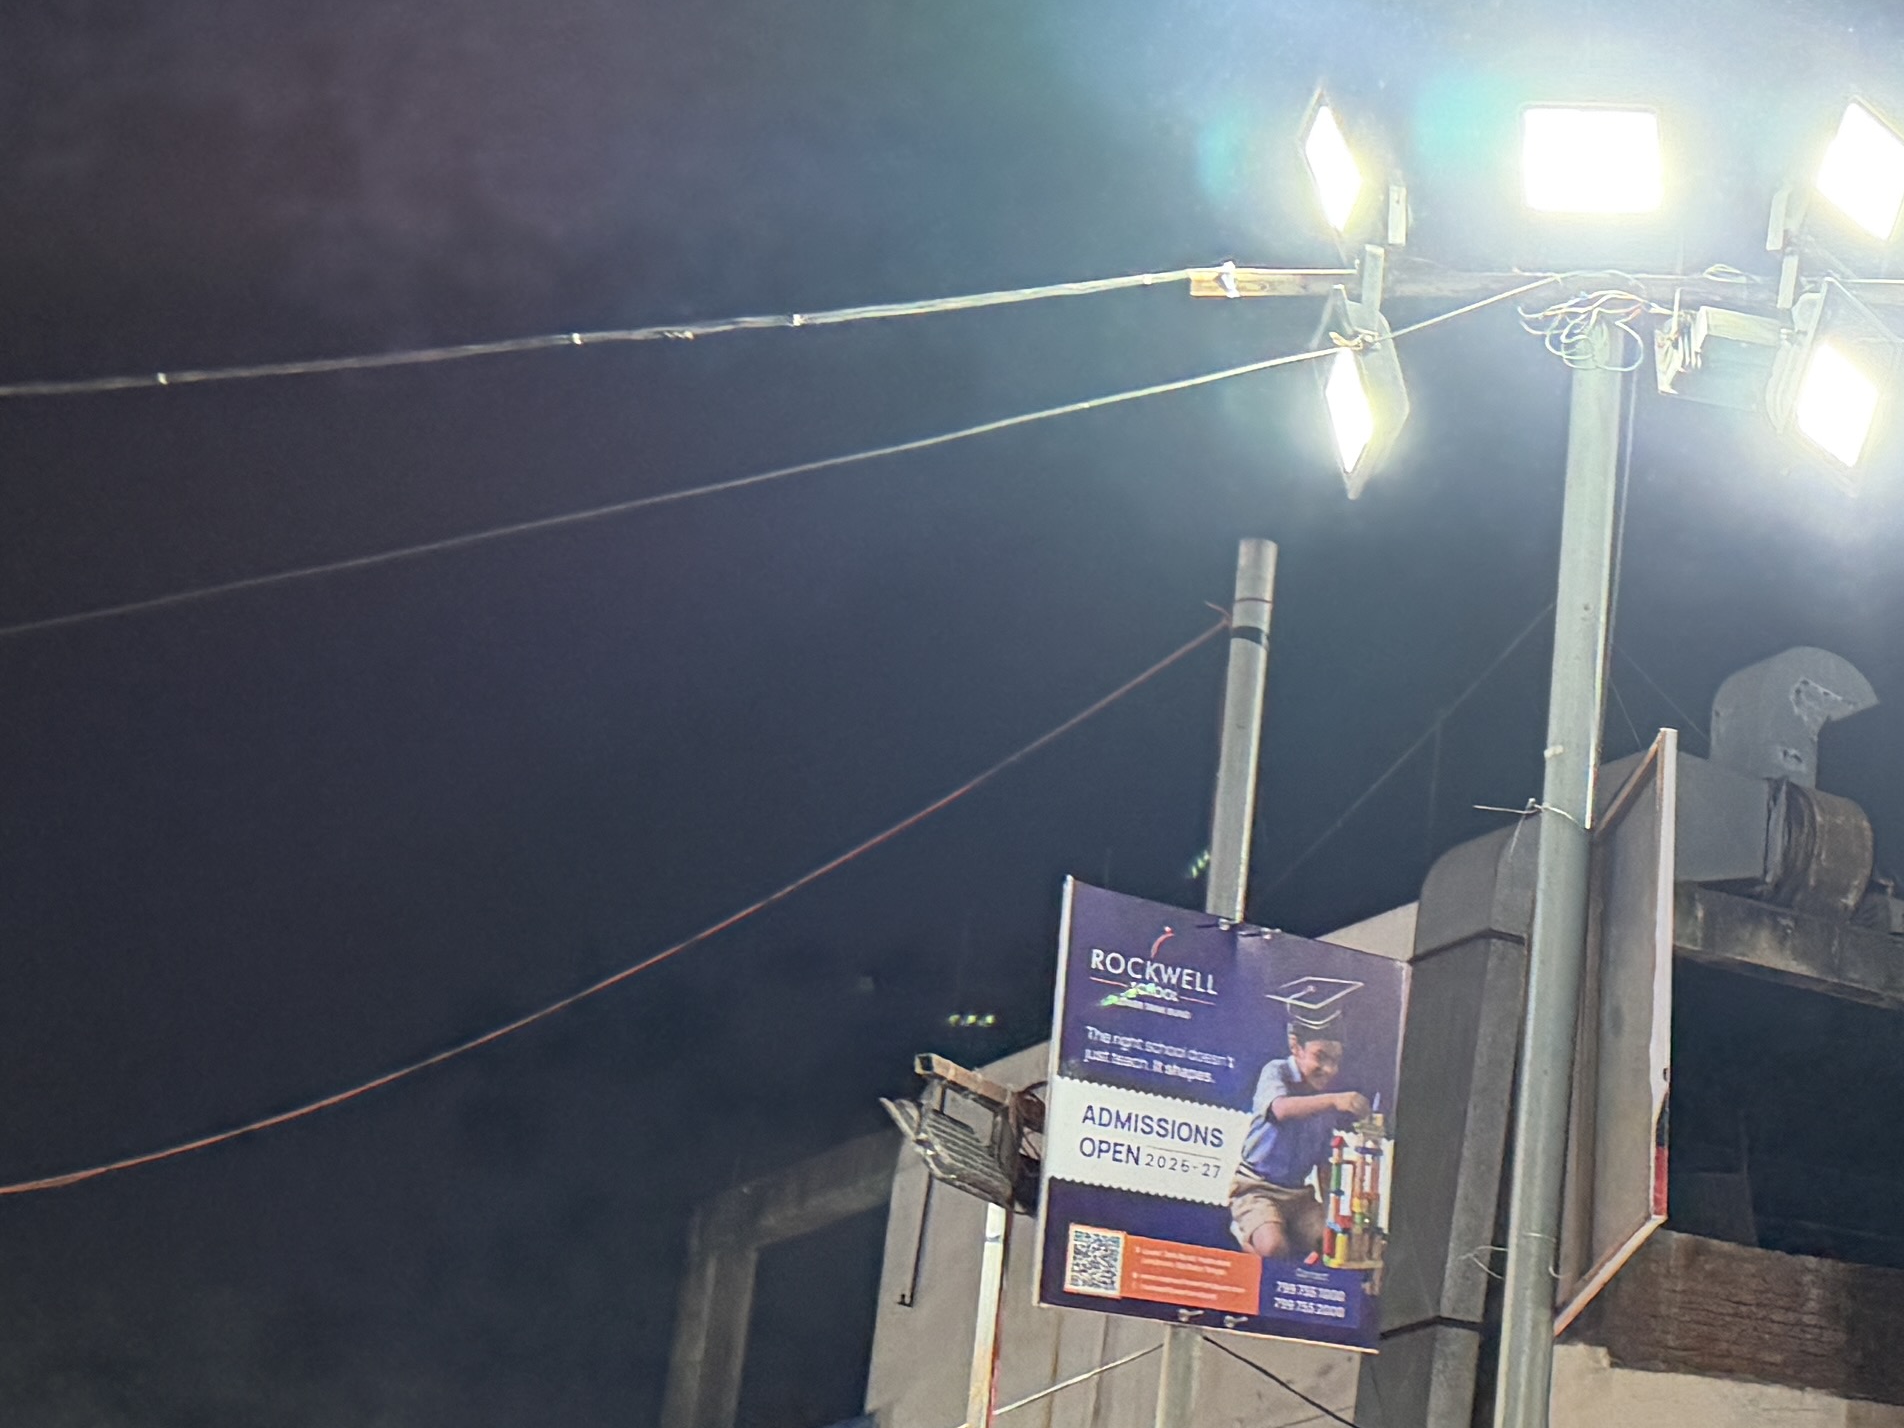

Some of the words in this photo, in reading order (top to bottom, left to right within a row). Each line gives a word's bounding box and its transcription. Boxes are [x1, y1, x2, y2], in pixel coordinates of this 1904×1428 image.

[1090, 948, 1218, 996] ROCKWELL
[1081, 1103, 1225, 1149] ADMISSIONS
[1079, 1136, 1142, 1167] OPEN
[1145, 1145, 1222, 1180] 2026-27
